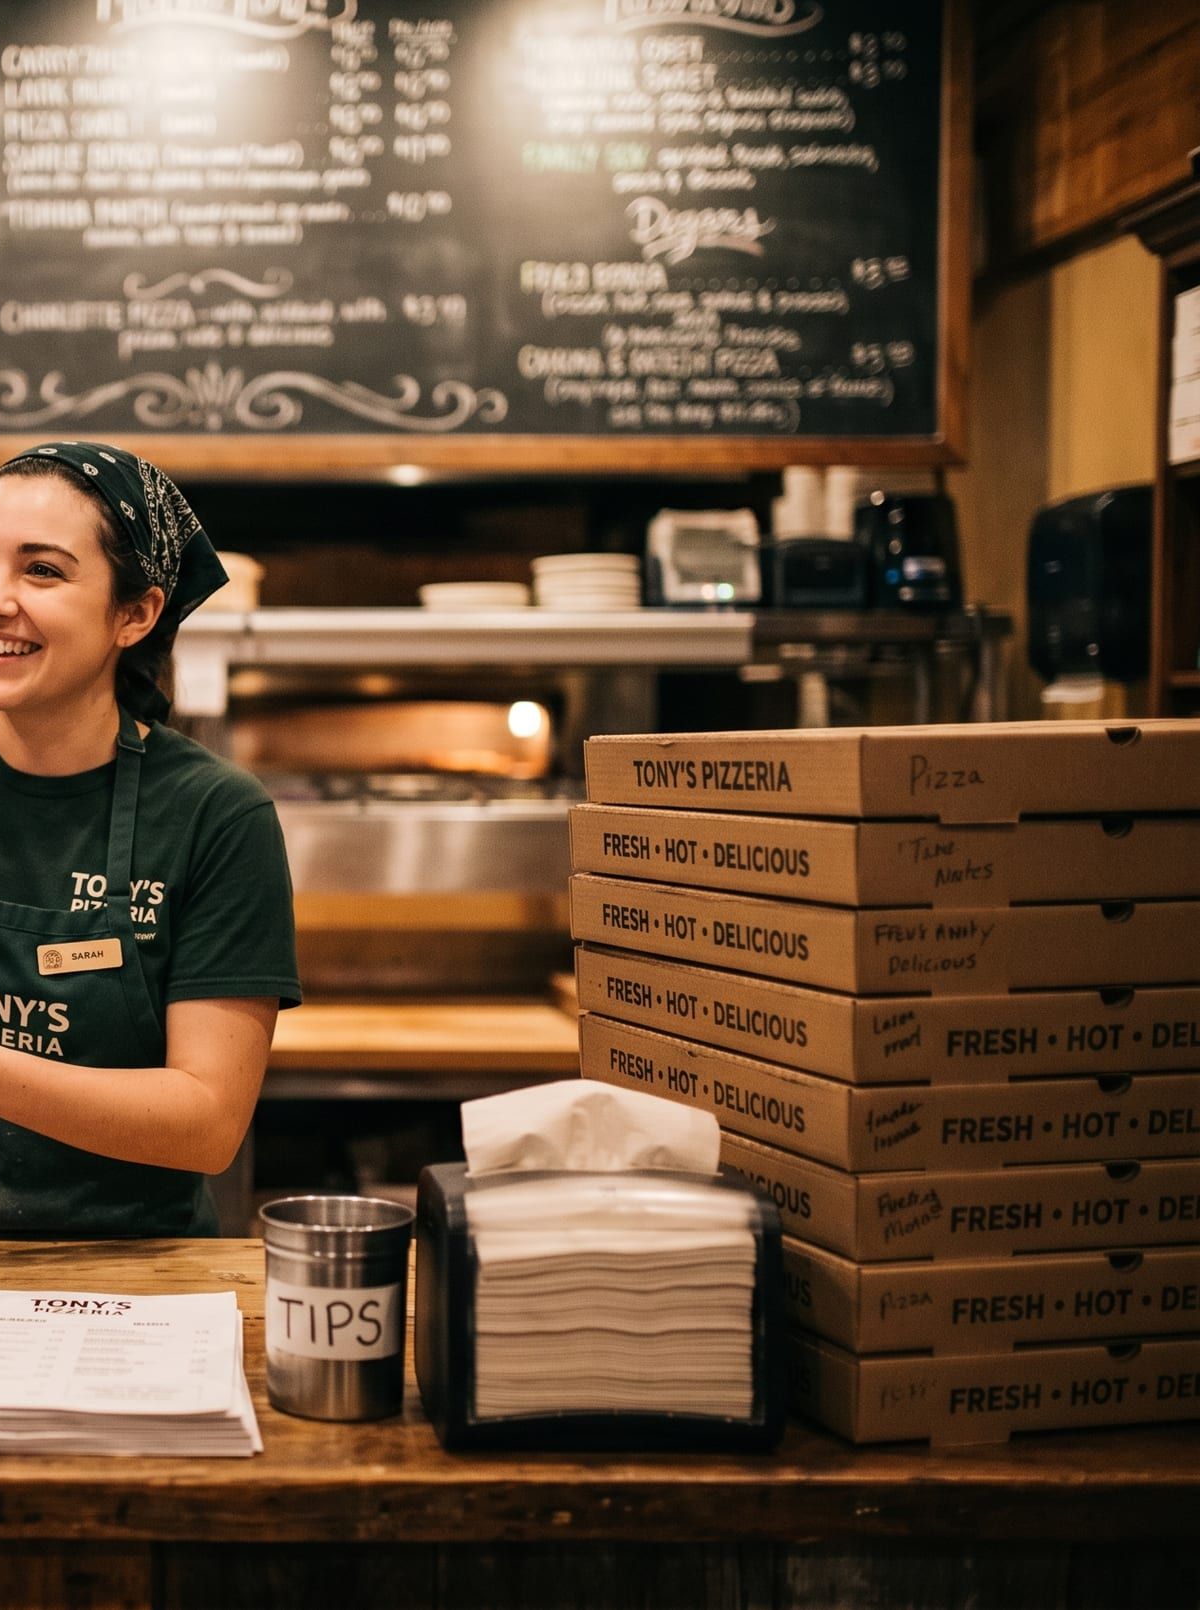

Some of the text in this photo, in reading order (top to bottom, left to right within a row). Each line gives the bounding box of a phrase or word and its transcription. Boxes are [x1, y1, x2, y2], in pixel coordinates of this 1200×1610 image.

[633, 760, 793, 792] TONY'S PIZZERIA
[909, 754, 985, 796] Pizza
[603, 832, 810, 877] FRESH HOT DELICIOUS
[71, 871, 165, 905] TOY'S
[70, 898, 157, 925] PIZRIA
[602, 903, 810, 961] FRESH HOT DELICIOUS
[71, 950, 104, 961] SARAH
[606, 976, 808, 1047] FRESH HOT DELICIOUS
[947, 1027, 1038, 1057] FRESH
[1067, 1024, 1124, 1052] HOT
[609, 1047, 806, 1134] FRESH HOT DELICIOUS
[941, 1114, 1033, 1145] FRESH
[1062, 1111, 1121, 1139] HOT
[950, 1202, 1043, 1233] FRESH
[1072, 1199, 1130, 1227] HOT
[1158, 1195, 1200, 1222] DE
[30, 1298, 133, 1310] TONY'S
[34, 1307, 124, 1316] PIZZERIA
[278, 1296, 382, 1347] TIPS
[951, 1285, 1200, 1325] FRESH HOT DE
[948, 1383, 1042, 1415] FRESH
[1070, 1378, 1129, 1407] HOT
[1156, 1373, 1200, 1400] DE
